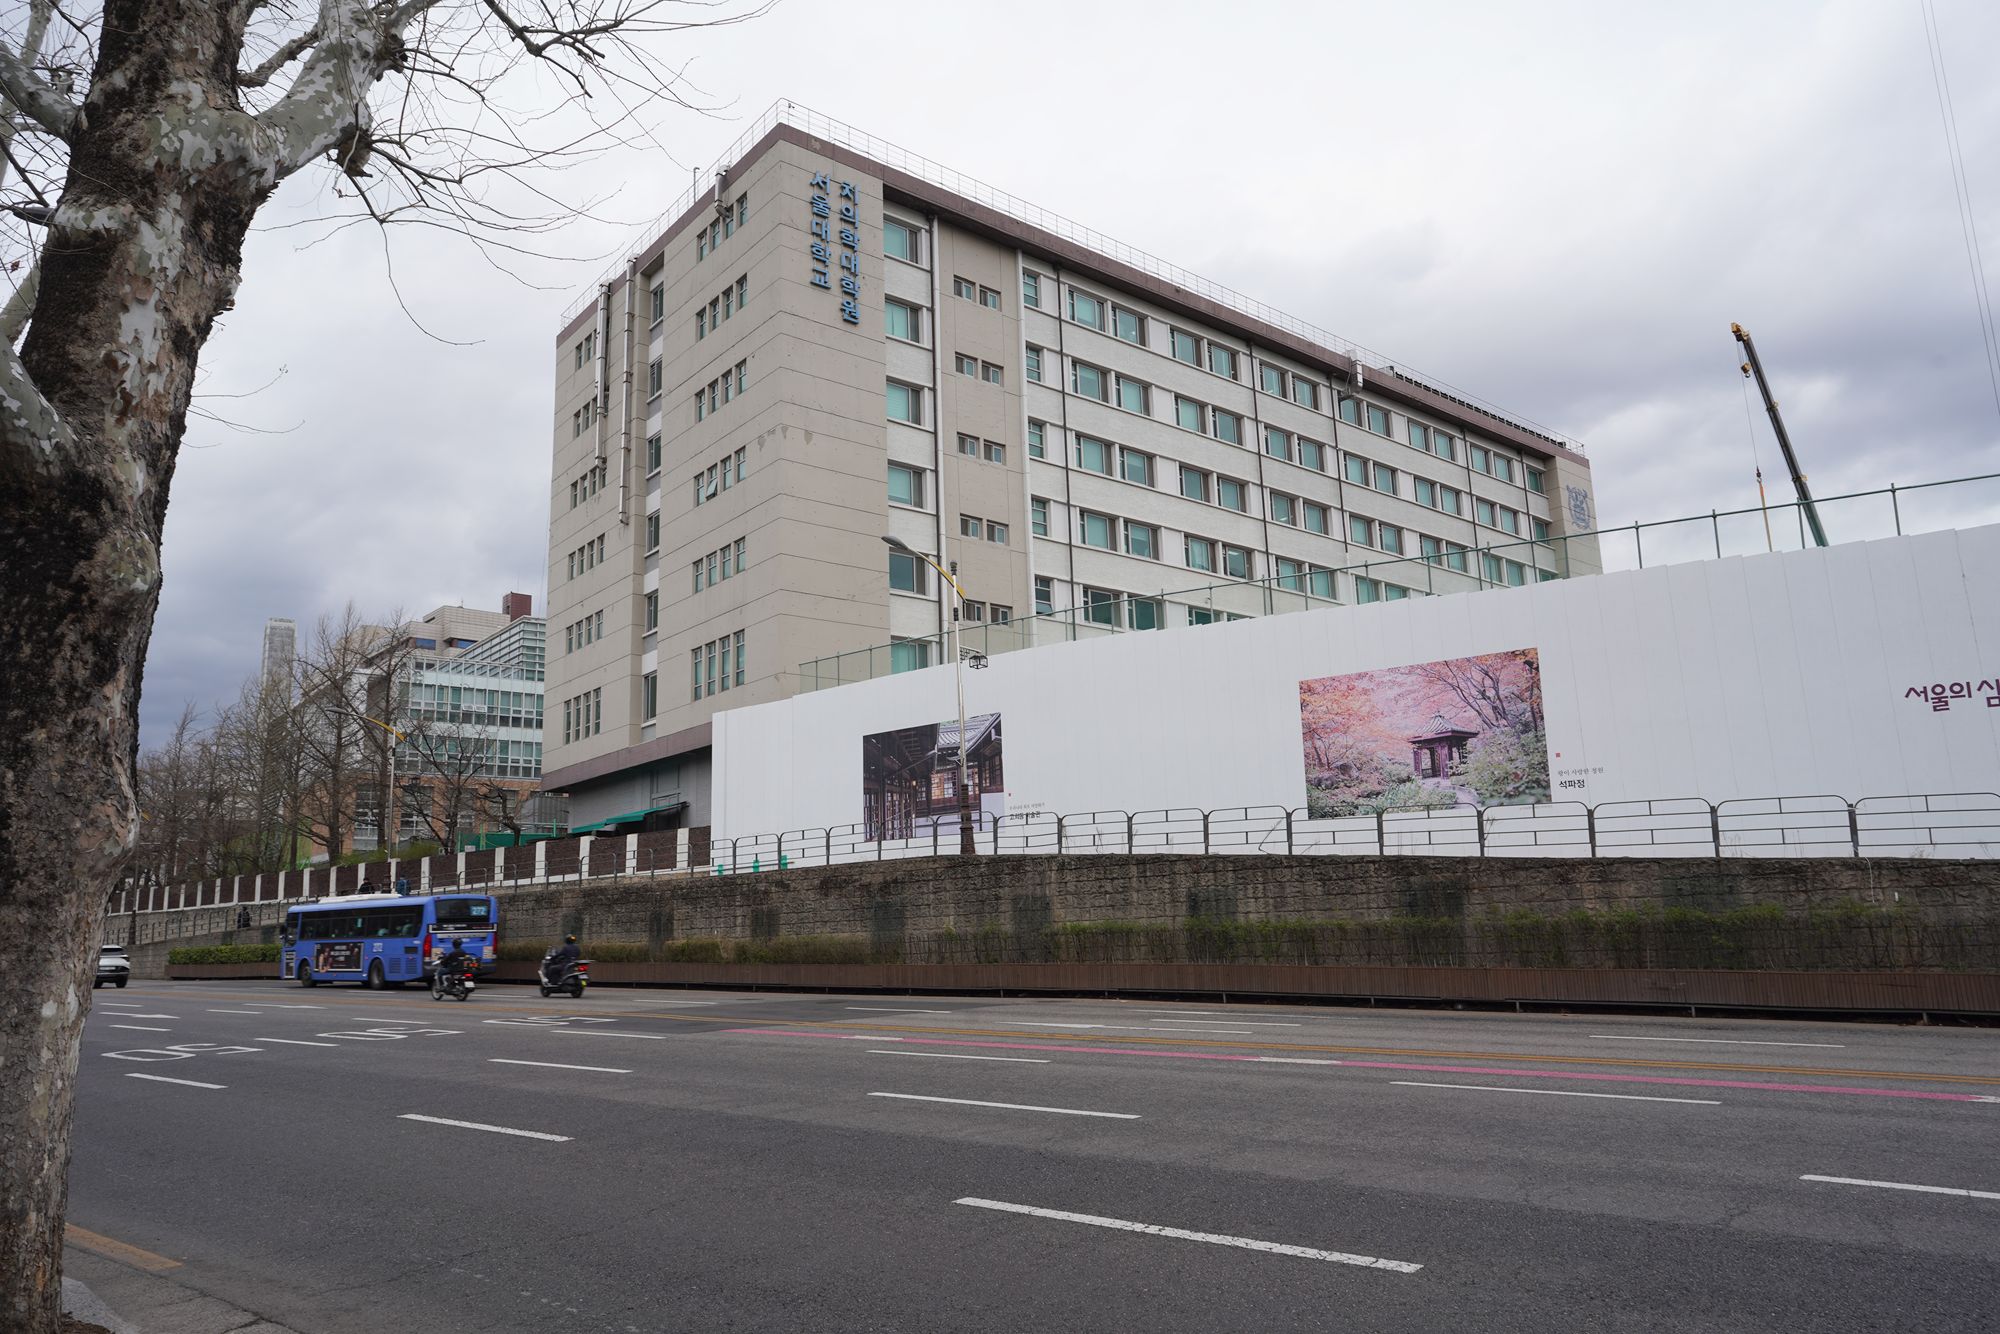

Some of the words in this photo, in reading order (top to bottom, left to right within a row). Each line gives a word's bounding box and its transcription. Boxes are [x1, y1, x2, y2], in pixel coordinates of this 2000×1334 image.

[810, 170, 832, 289] 서울대학교
[840, 181, 861, 324] 치의학대학원
[1904, 681, 1972, 712] 서울의
[1559, 779, 1585, 789] 석파정
[471, 906, 486, 916] 272
